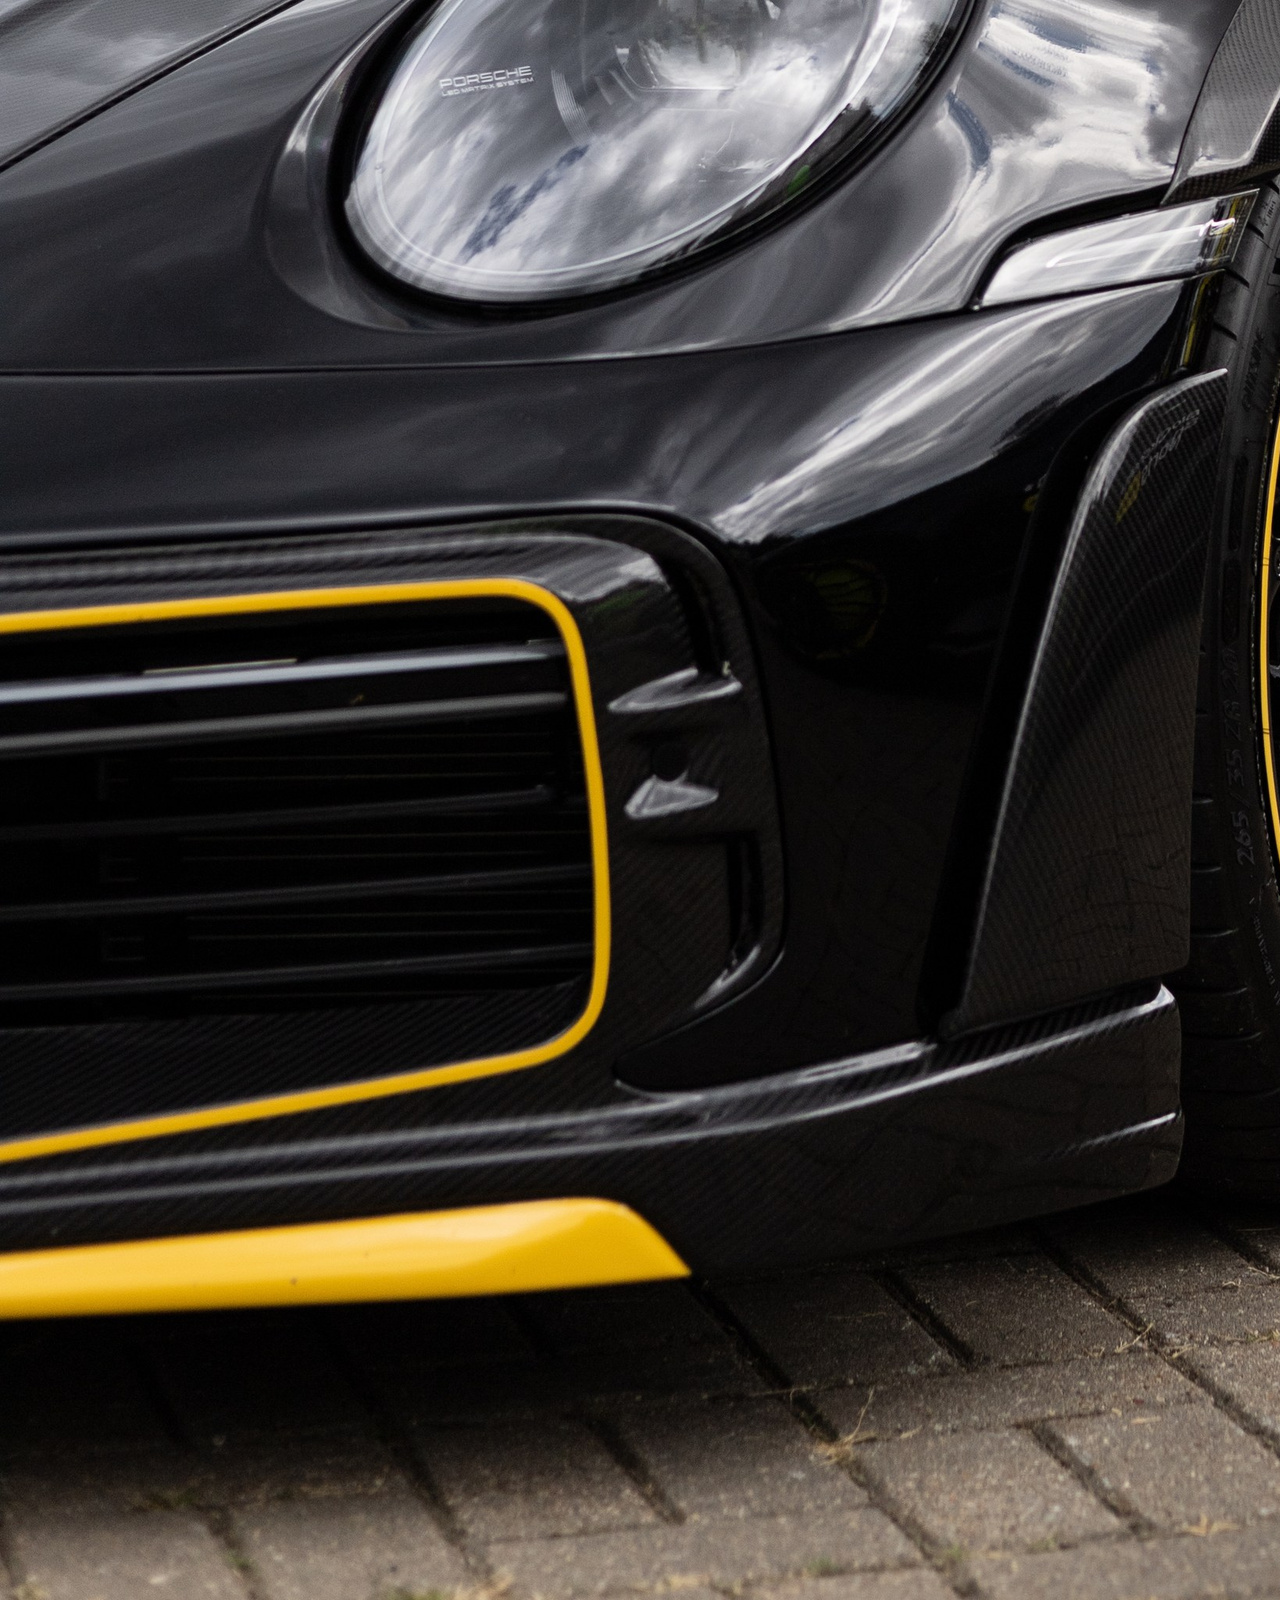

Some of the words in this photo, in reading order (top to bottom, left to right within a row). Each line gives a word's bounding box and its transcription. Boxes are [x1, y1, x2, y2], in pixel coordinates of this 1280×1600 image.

[440, 65, 533, 89] PORSCHE
[442, 88, 460, 97] LED
[461, 83, 495, 93] MATRIX
[496, 77, 535, 88] SYSTEM
